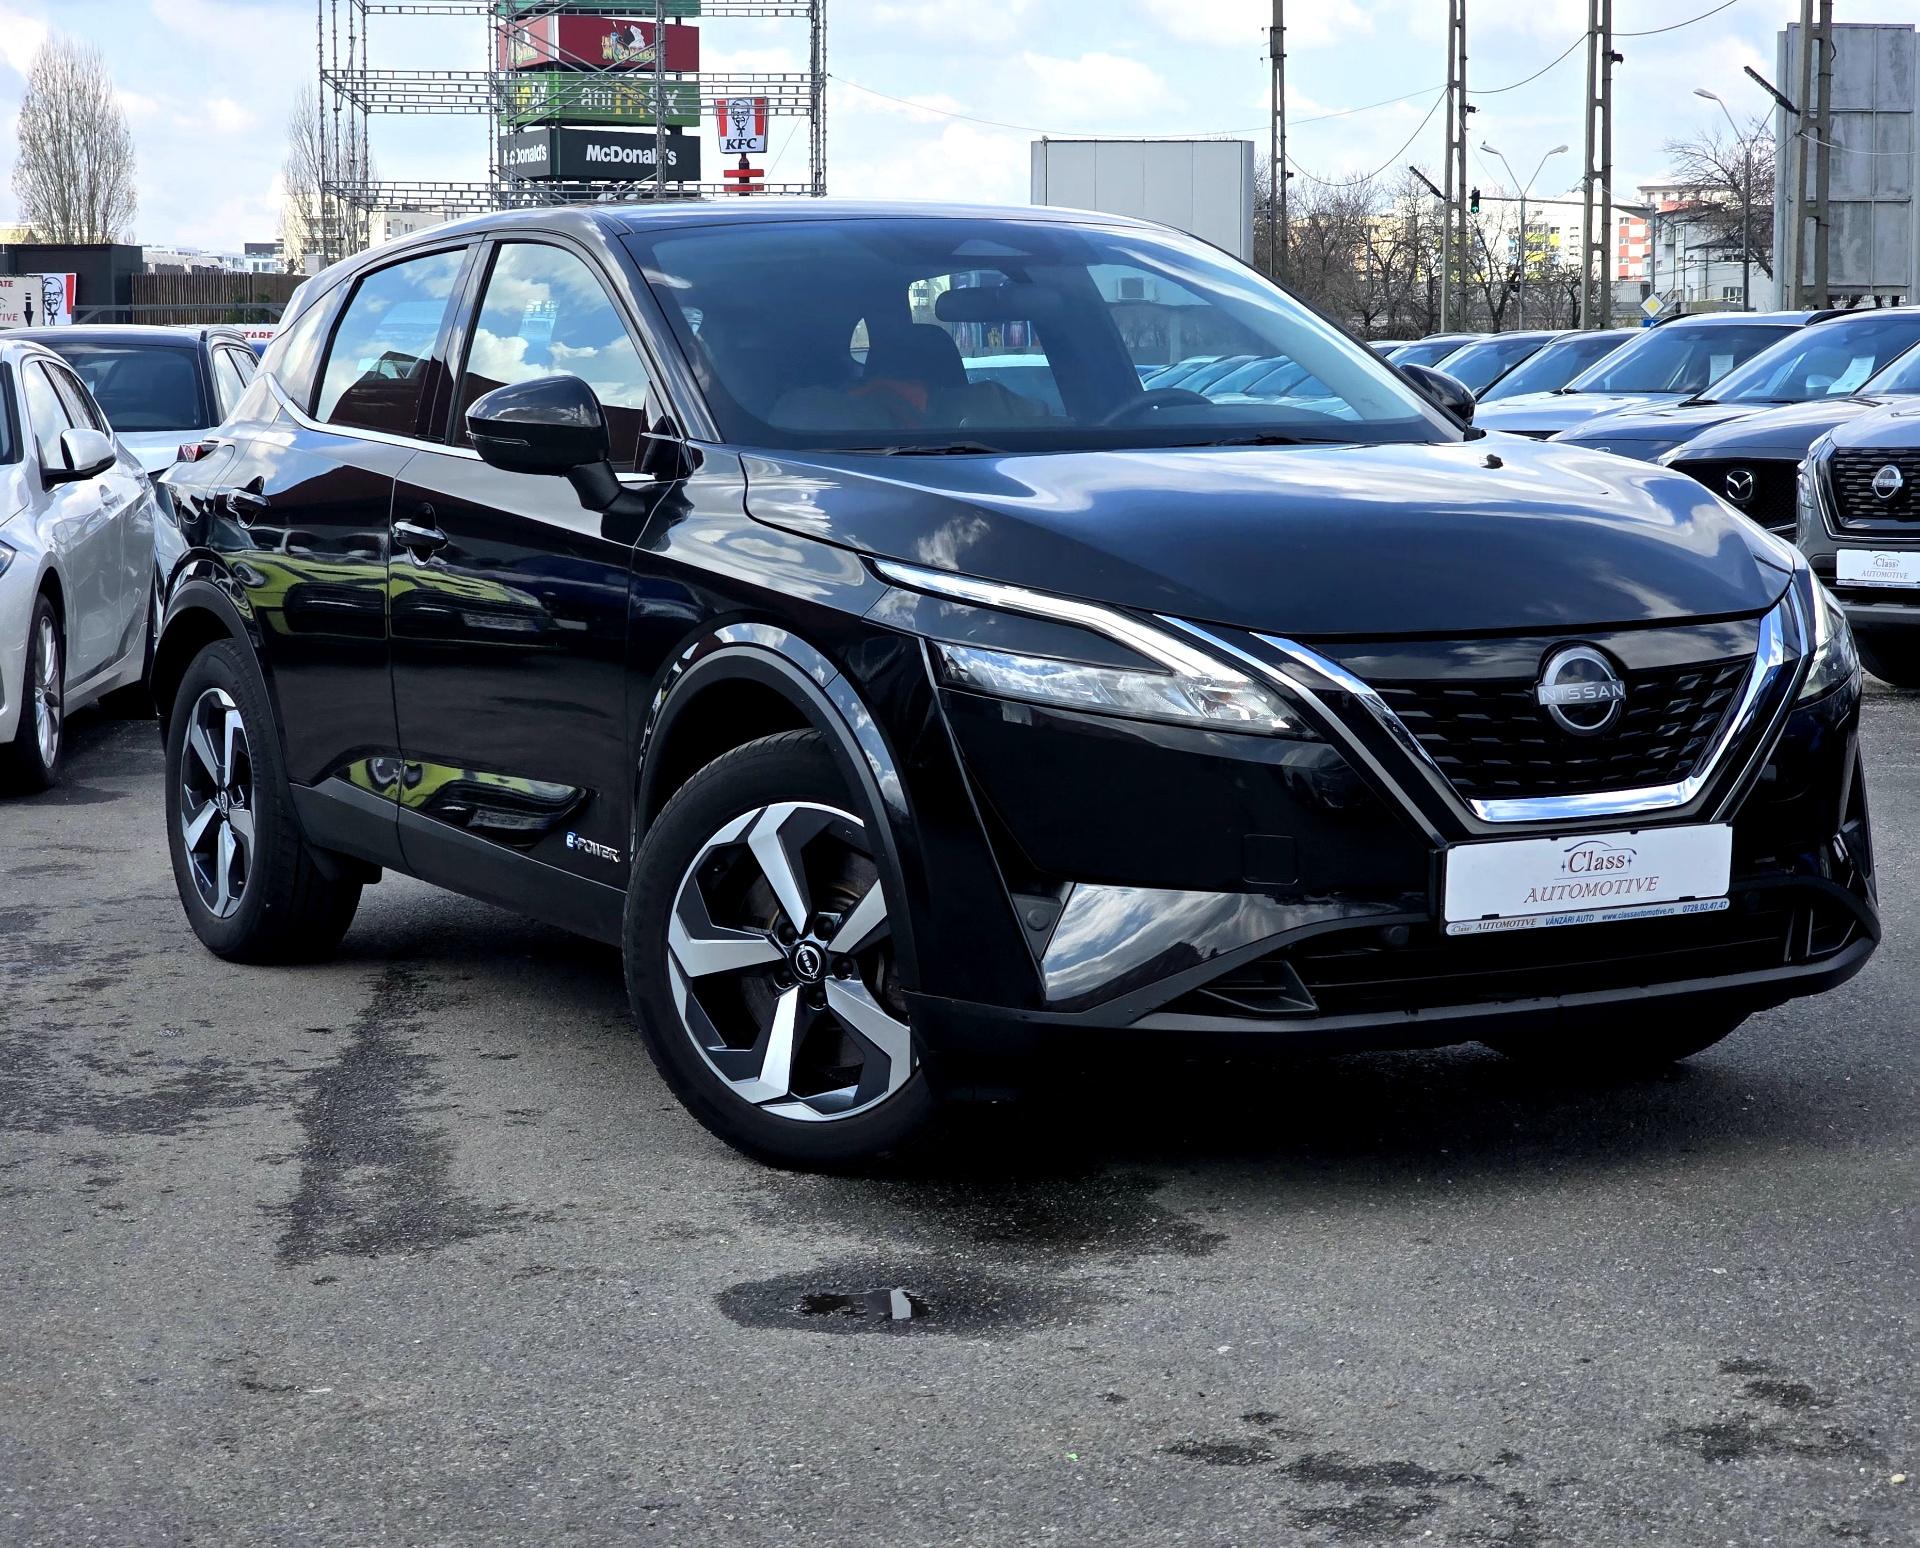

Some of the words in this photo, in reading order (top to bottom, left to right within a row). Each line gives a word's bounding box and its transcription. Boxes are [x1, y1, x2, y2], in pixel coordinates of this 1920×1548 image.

[725, 137, 757, 149] KFC
[586, 144, 677, 166] McDonal's
[1875, 557, 1896, 568] Class
[1860, 569, 1909, 580] AUTOMOTIVE
[1540, 683, 1624, 701] NISSAN
[1568, 850, 1626, 873] Class
[1523, 876, 1660, 904] AUTOMOTIVE
[1475, 918, 1538, 931] AUTOMOTIVE
[1576, 914, 1595, 923] AUTO
